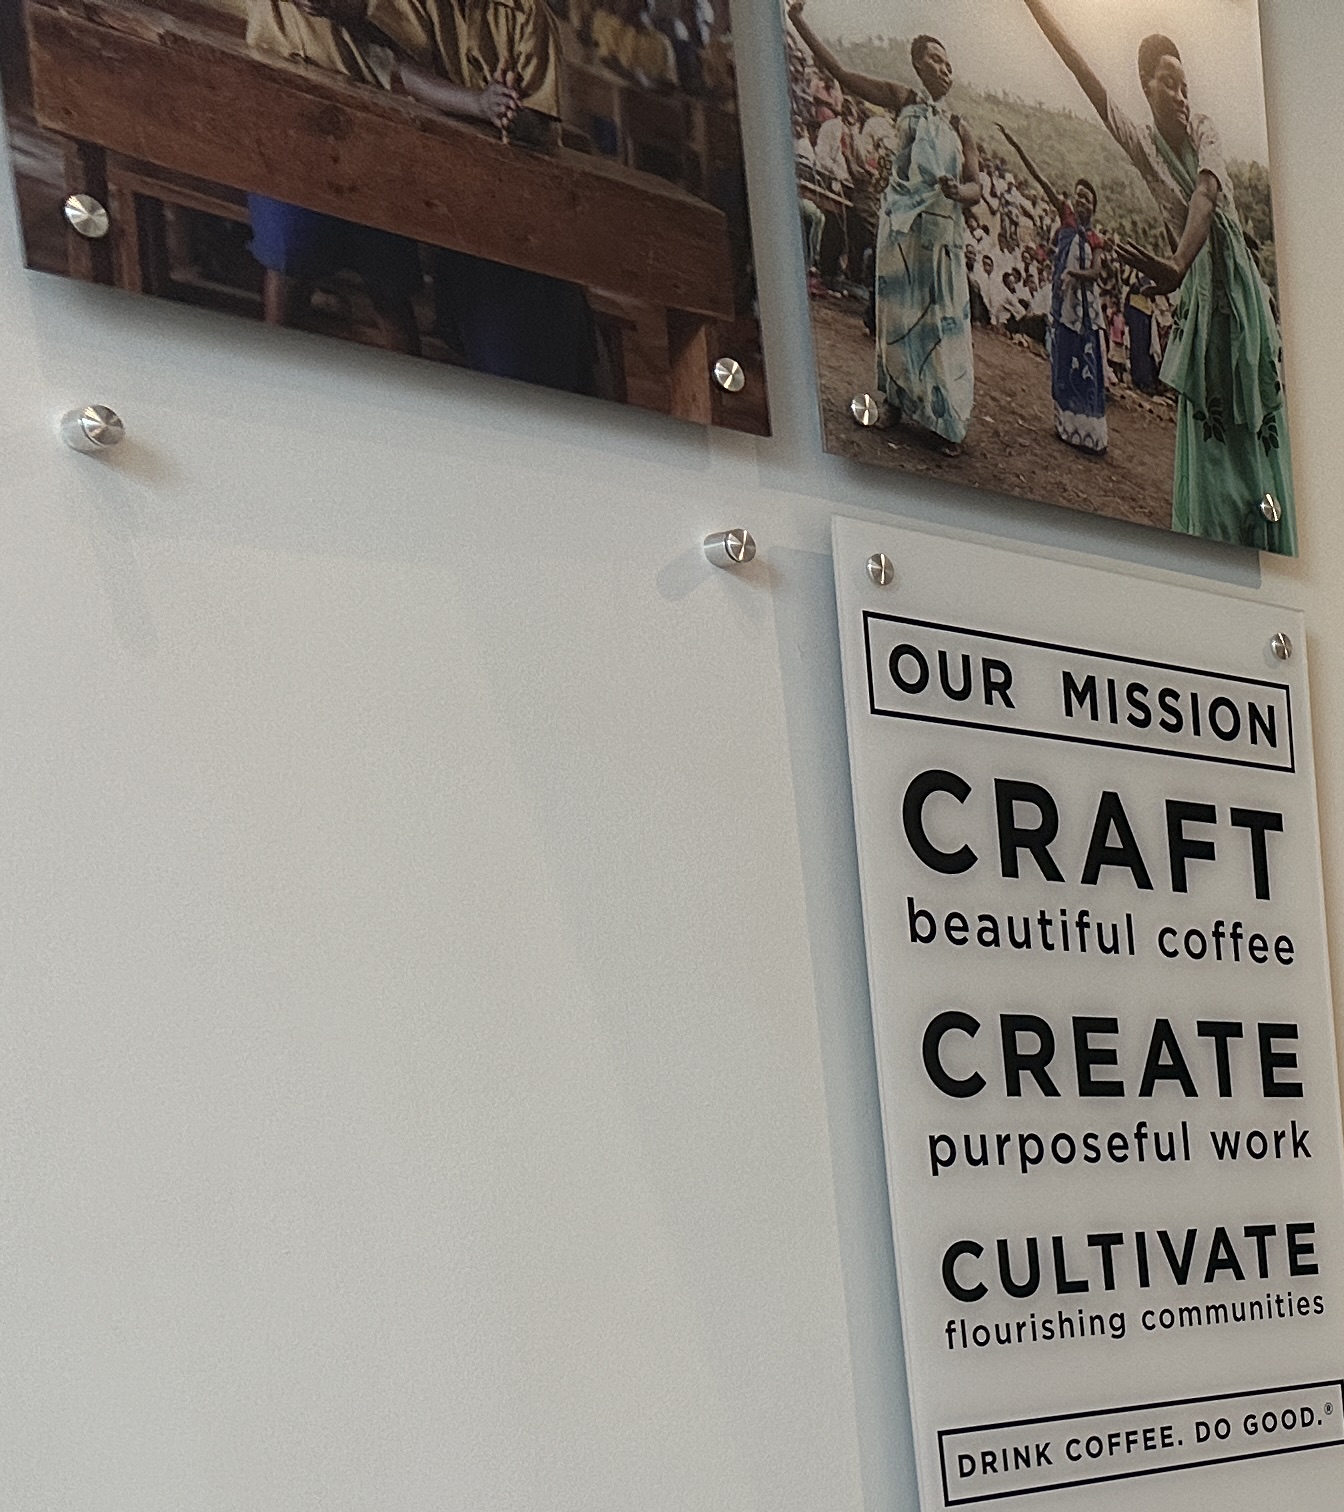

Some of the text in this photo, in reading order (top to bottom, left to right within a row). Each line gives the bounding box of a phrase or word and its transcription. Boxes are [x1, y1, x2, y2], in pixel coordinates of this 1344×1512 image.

[889, 644, 1278, 749] OUR MISSION
[902, 770, 1283, 900] CRAFT
[907, 898, 1295, 965] beautiful coffee
[922, 1011, 1304, 1098] CREATE
[928, 1120, 1312, 1174] purposeful work
[942, 1223, 1320, 1303] CULTIVATE
[945, 1292, 1325, 1349] flourishing communities
[957, 1443, 1054, 1479] DRINK
[1065, 1425, 1185, 1463] COFFEE.
[1195, 1419, 1232, 1444] DO
